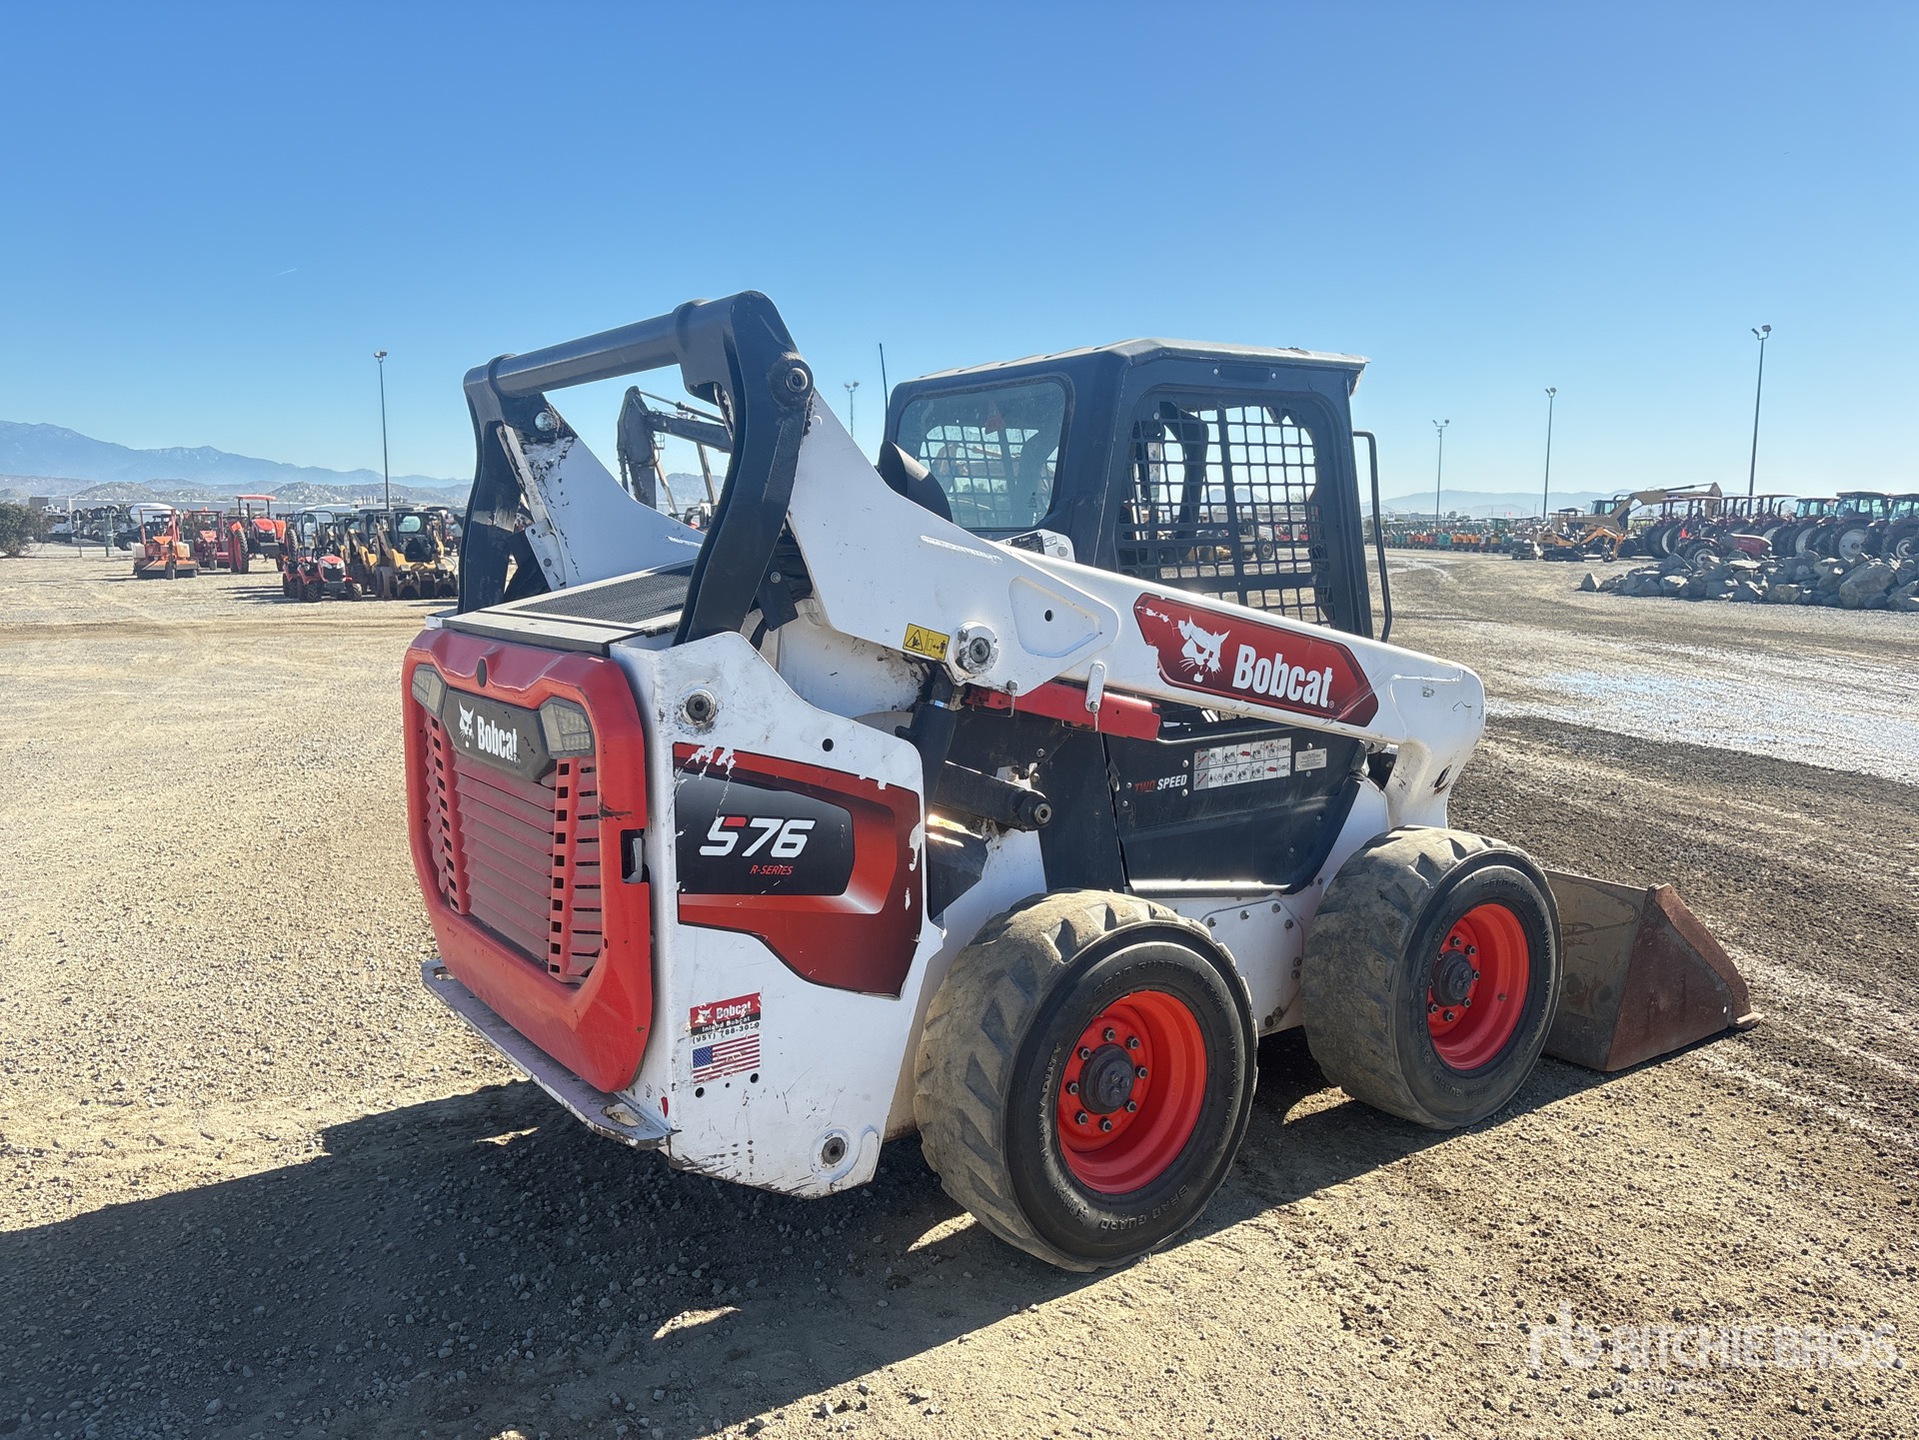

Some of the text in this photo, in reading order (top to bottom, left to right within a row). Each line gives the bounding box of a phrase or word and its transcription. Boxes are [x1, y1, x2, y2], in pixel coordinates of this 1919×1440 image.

[1232, 644, 1333, 708] Bobcat
[477, 715, 518, 762] Bobcat
[1157, 774, 1187, 790] SPEED
[699, 816, 816, 858] S76
[749, 864, 794, 875] R-SERIES
[1100, 1214, 1147, 1230] GUARD
